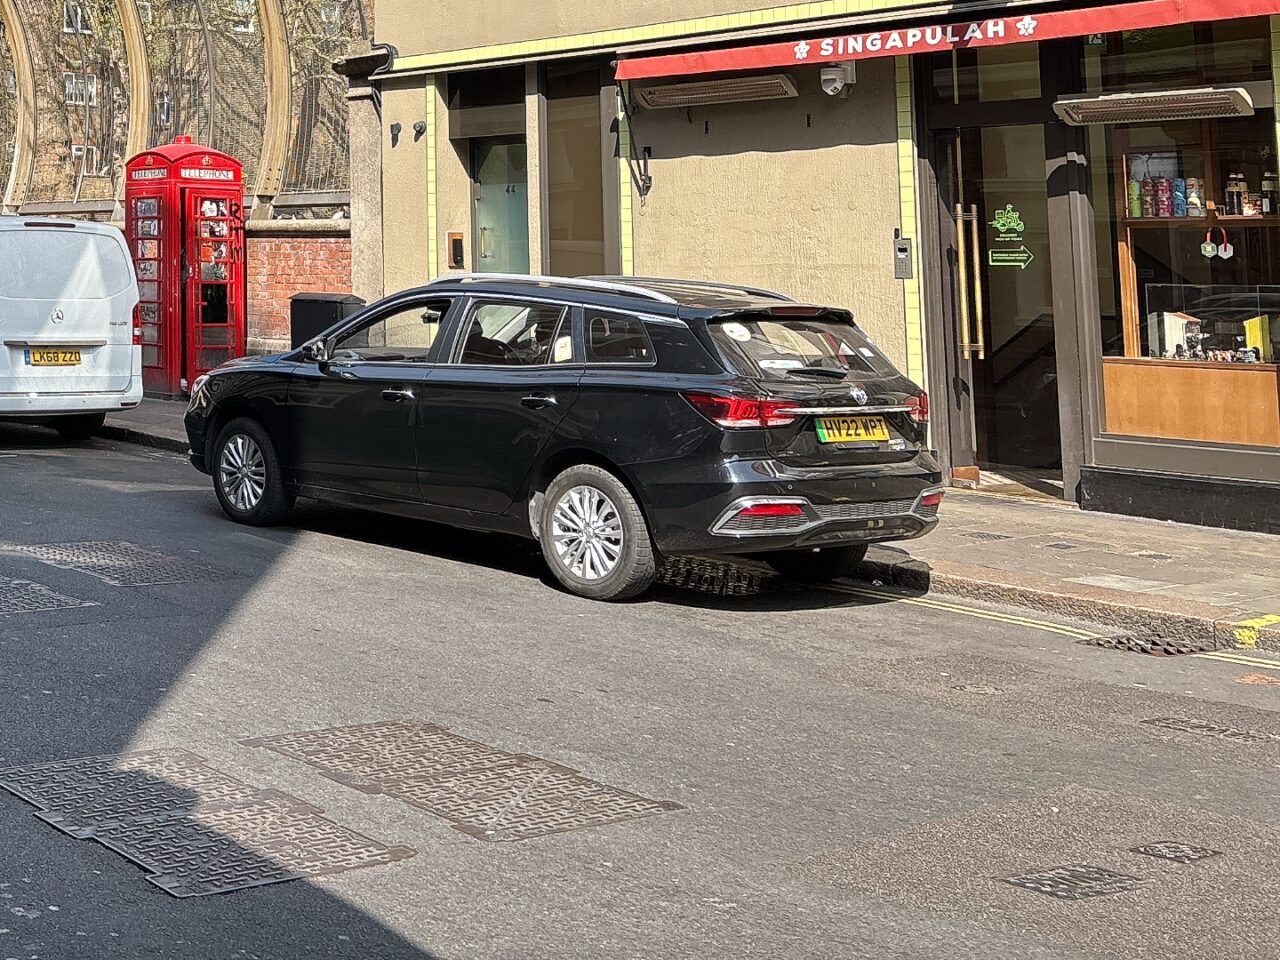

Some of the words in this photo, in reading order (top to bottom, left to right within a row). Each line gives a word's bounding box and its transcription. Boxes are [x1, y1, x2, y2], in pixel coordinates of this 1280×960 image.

[820, 19, 1005, 56] SINGAPULAH
[184, 169, 231, 179] TELEPHONE
[505, 184, 516, 193] 44
[32, 350, 59, 363] LK68
[823, 419, 861, 438] HV22
[862, 419, 886, 436] WPT
